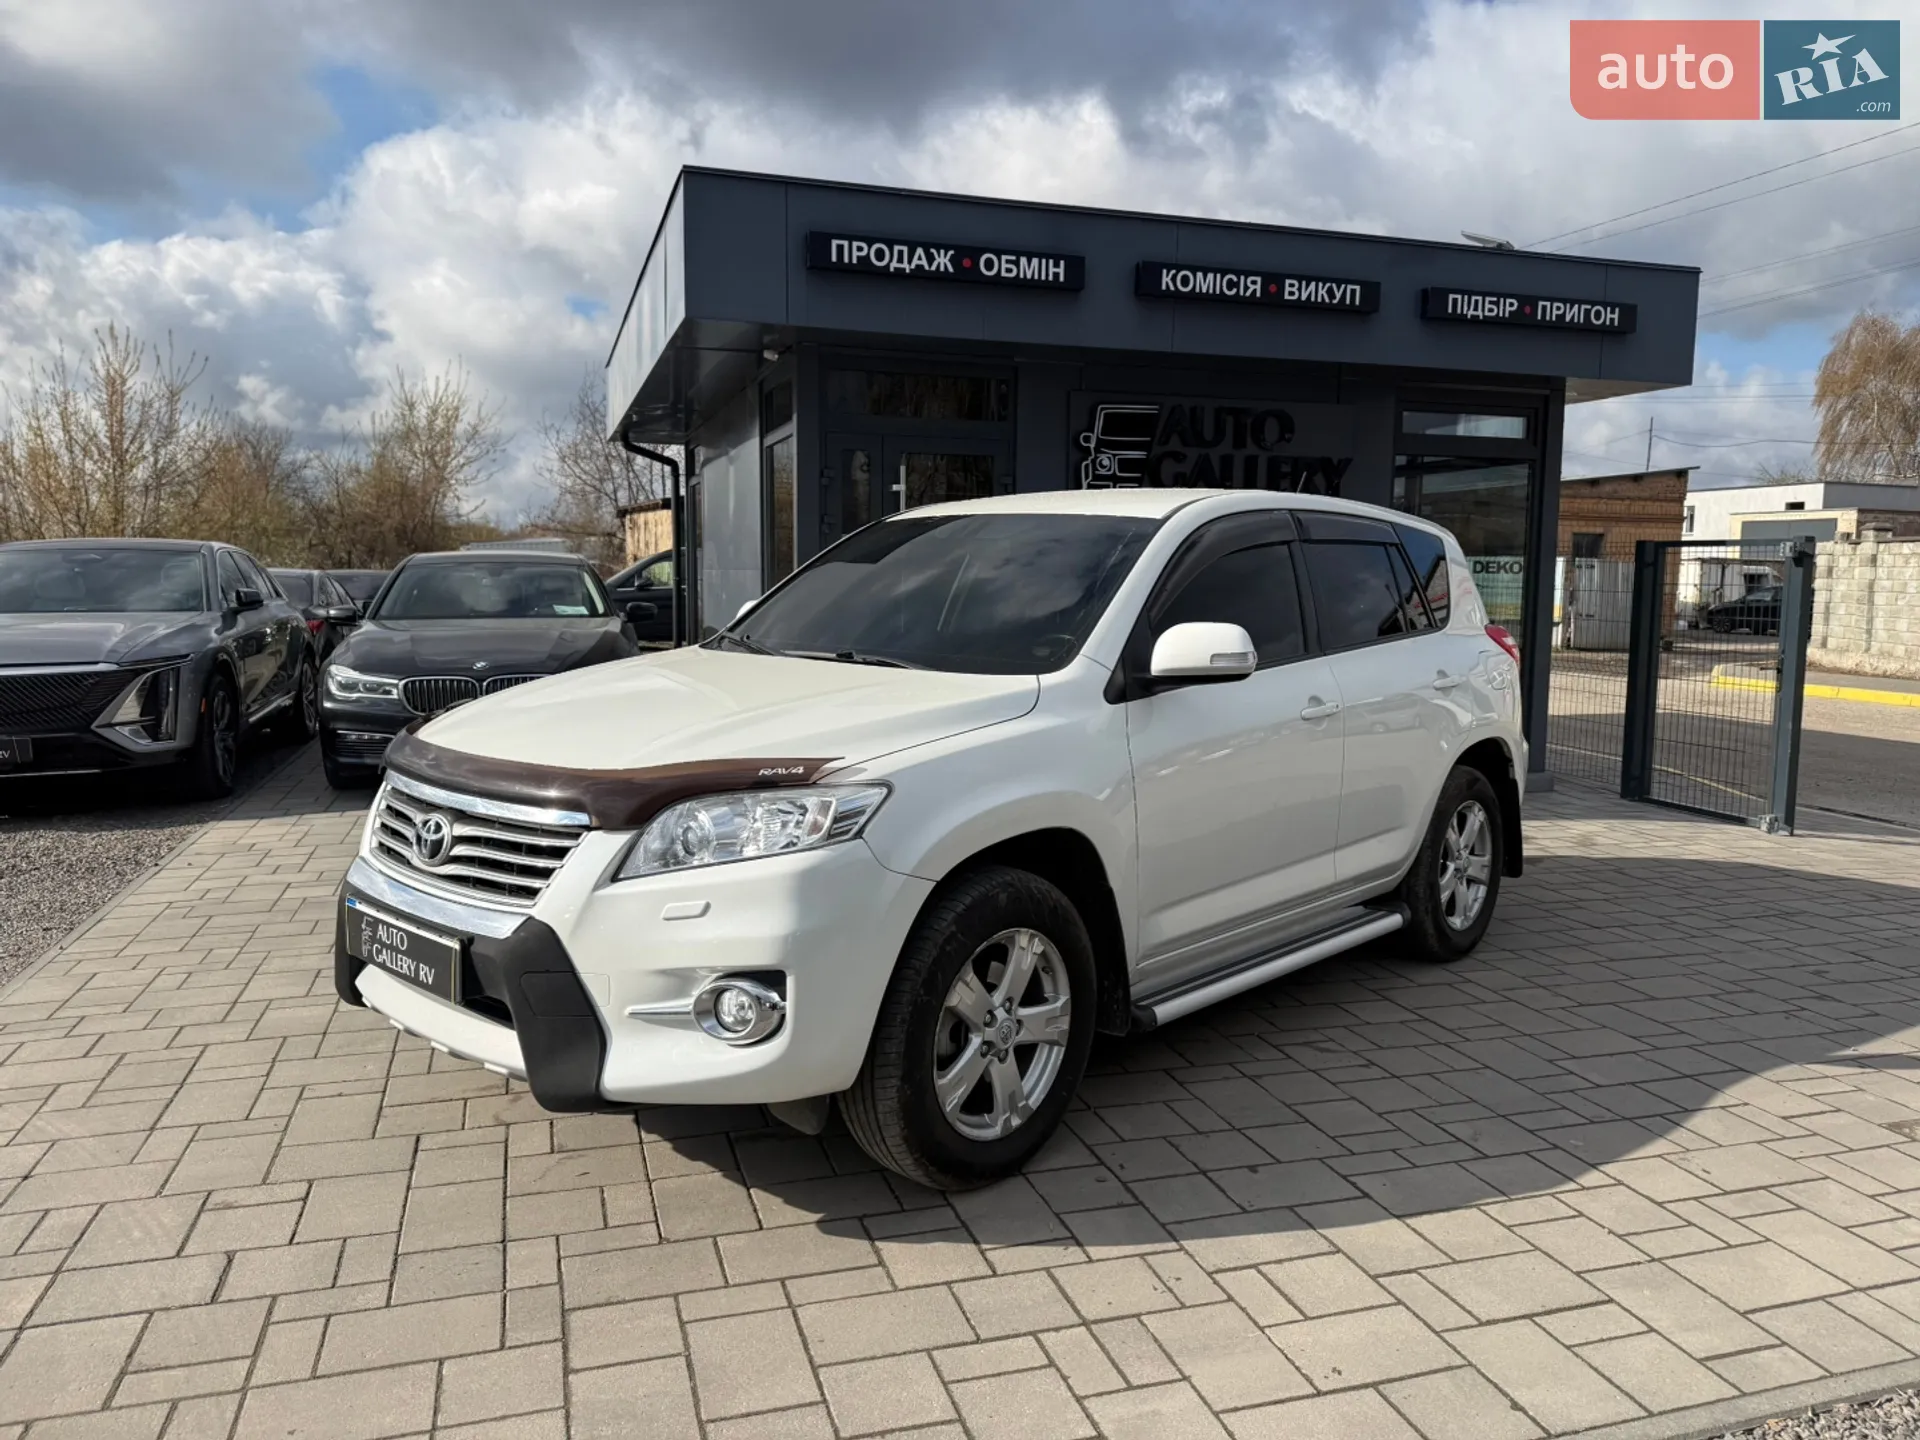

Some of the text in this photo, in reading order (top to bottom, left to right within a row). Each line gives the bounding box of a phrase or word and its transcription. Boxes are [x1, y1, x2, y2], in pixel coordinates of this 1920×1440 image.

[830, 238, 1066, 282] ПРОДАЖ ОБМІН
[1160, 268, 1362, 306] КОМІСІЯ ВИКУП
[1447, 294, 1620, 327] ПІДБІР ПРИГОН
[1157, 403, 1296, 451] AUTO
[1146, 450, 1354, 496] GALLERY
[1472, 560, 1523, 575] DEKO
[758, 765, 804, 776] RAV4
[376, 922, 408, 951] AUTO
[372, 943, 435, 985] GALLERY RV
